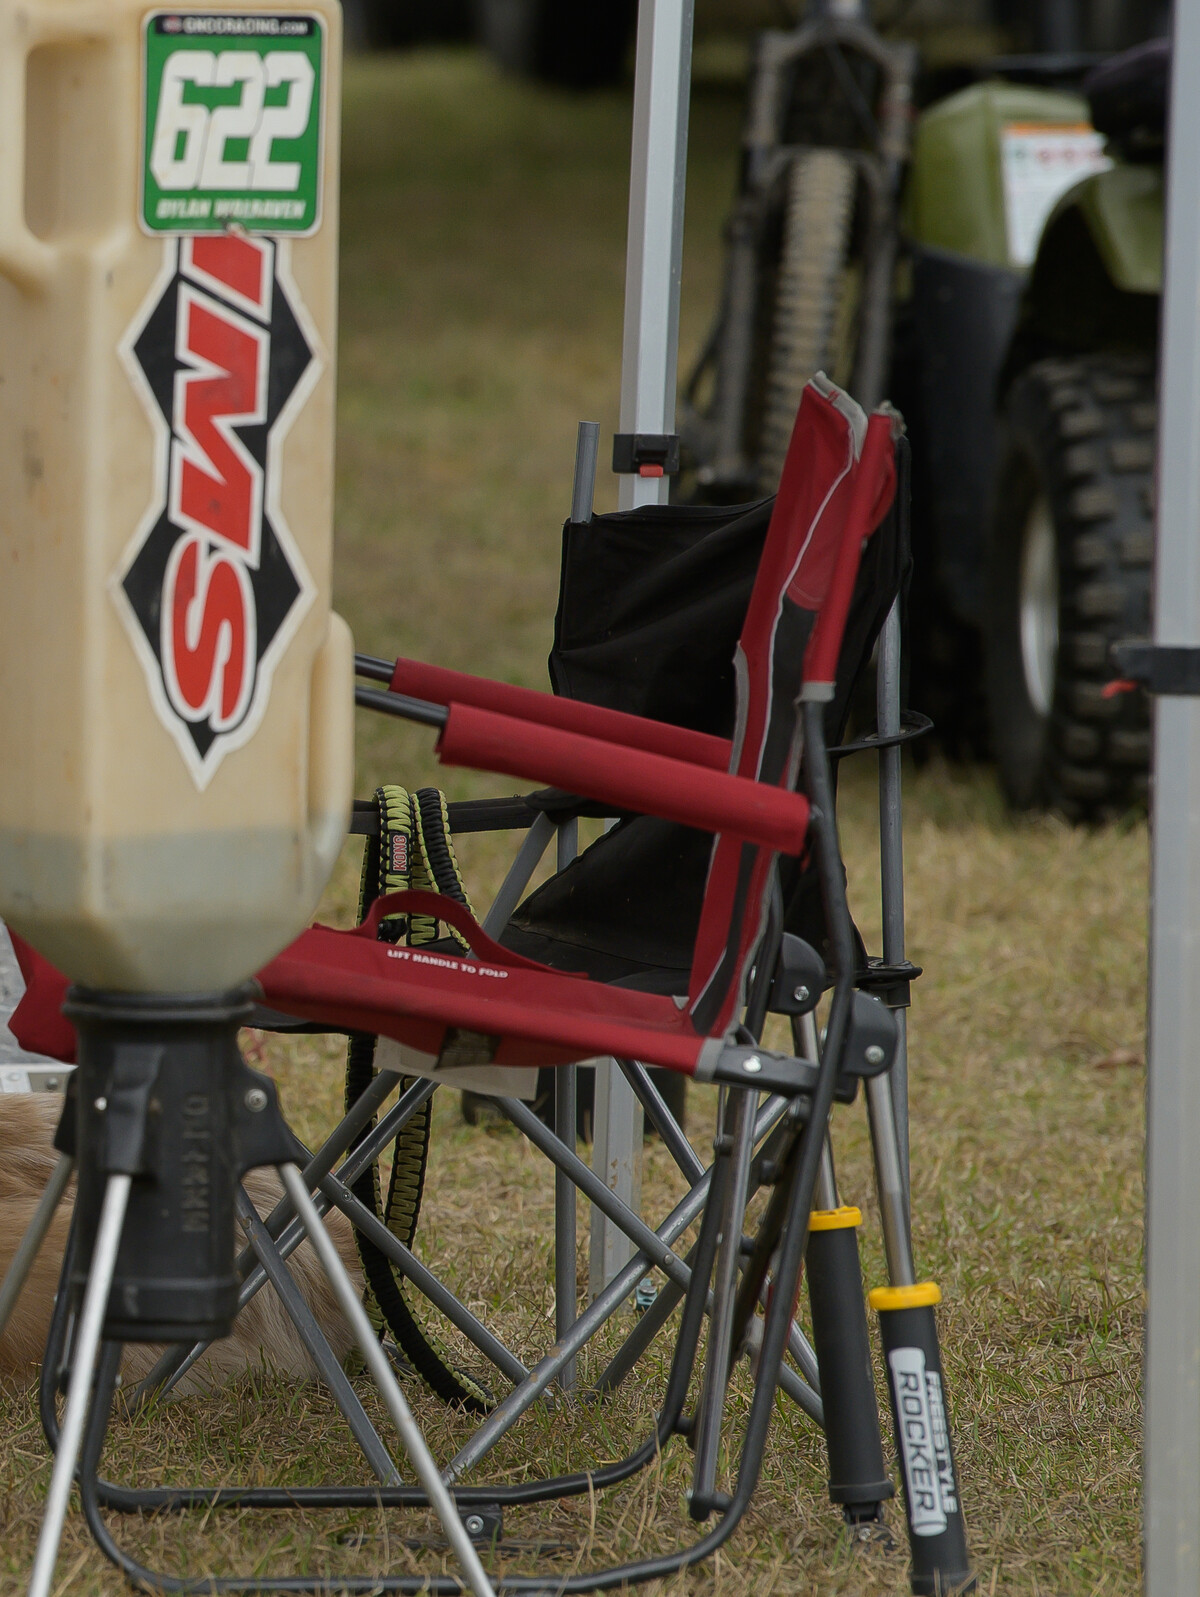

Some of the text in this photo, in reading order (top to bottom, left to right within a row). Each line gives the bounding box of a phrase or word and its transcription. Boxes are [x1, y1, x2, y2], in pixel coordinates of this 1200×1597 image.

[150, 50, 315, 191] 622
[155, 198, 211, 219] DYLAN
[165, 237, 268, 727] IMS
[393, 834, 407, 872] KONG
[387, 949, 509, 979] LIFT HANDLE TO FOLD
[898, 1372, 935, 1511] ROCKER
[926, 1371, 958, 1513] FREESTYLE
